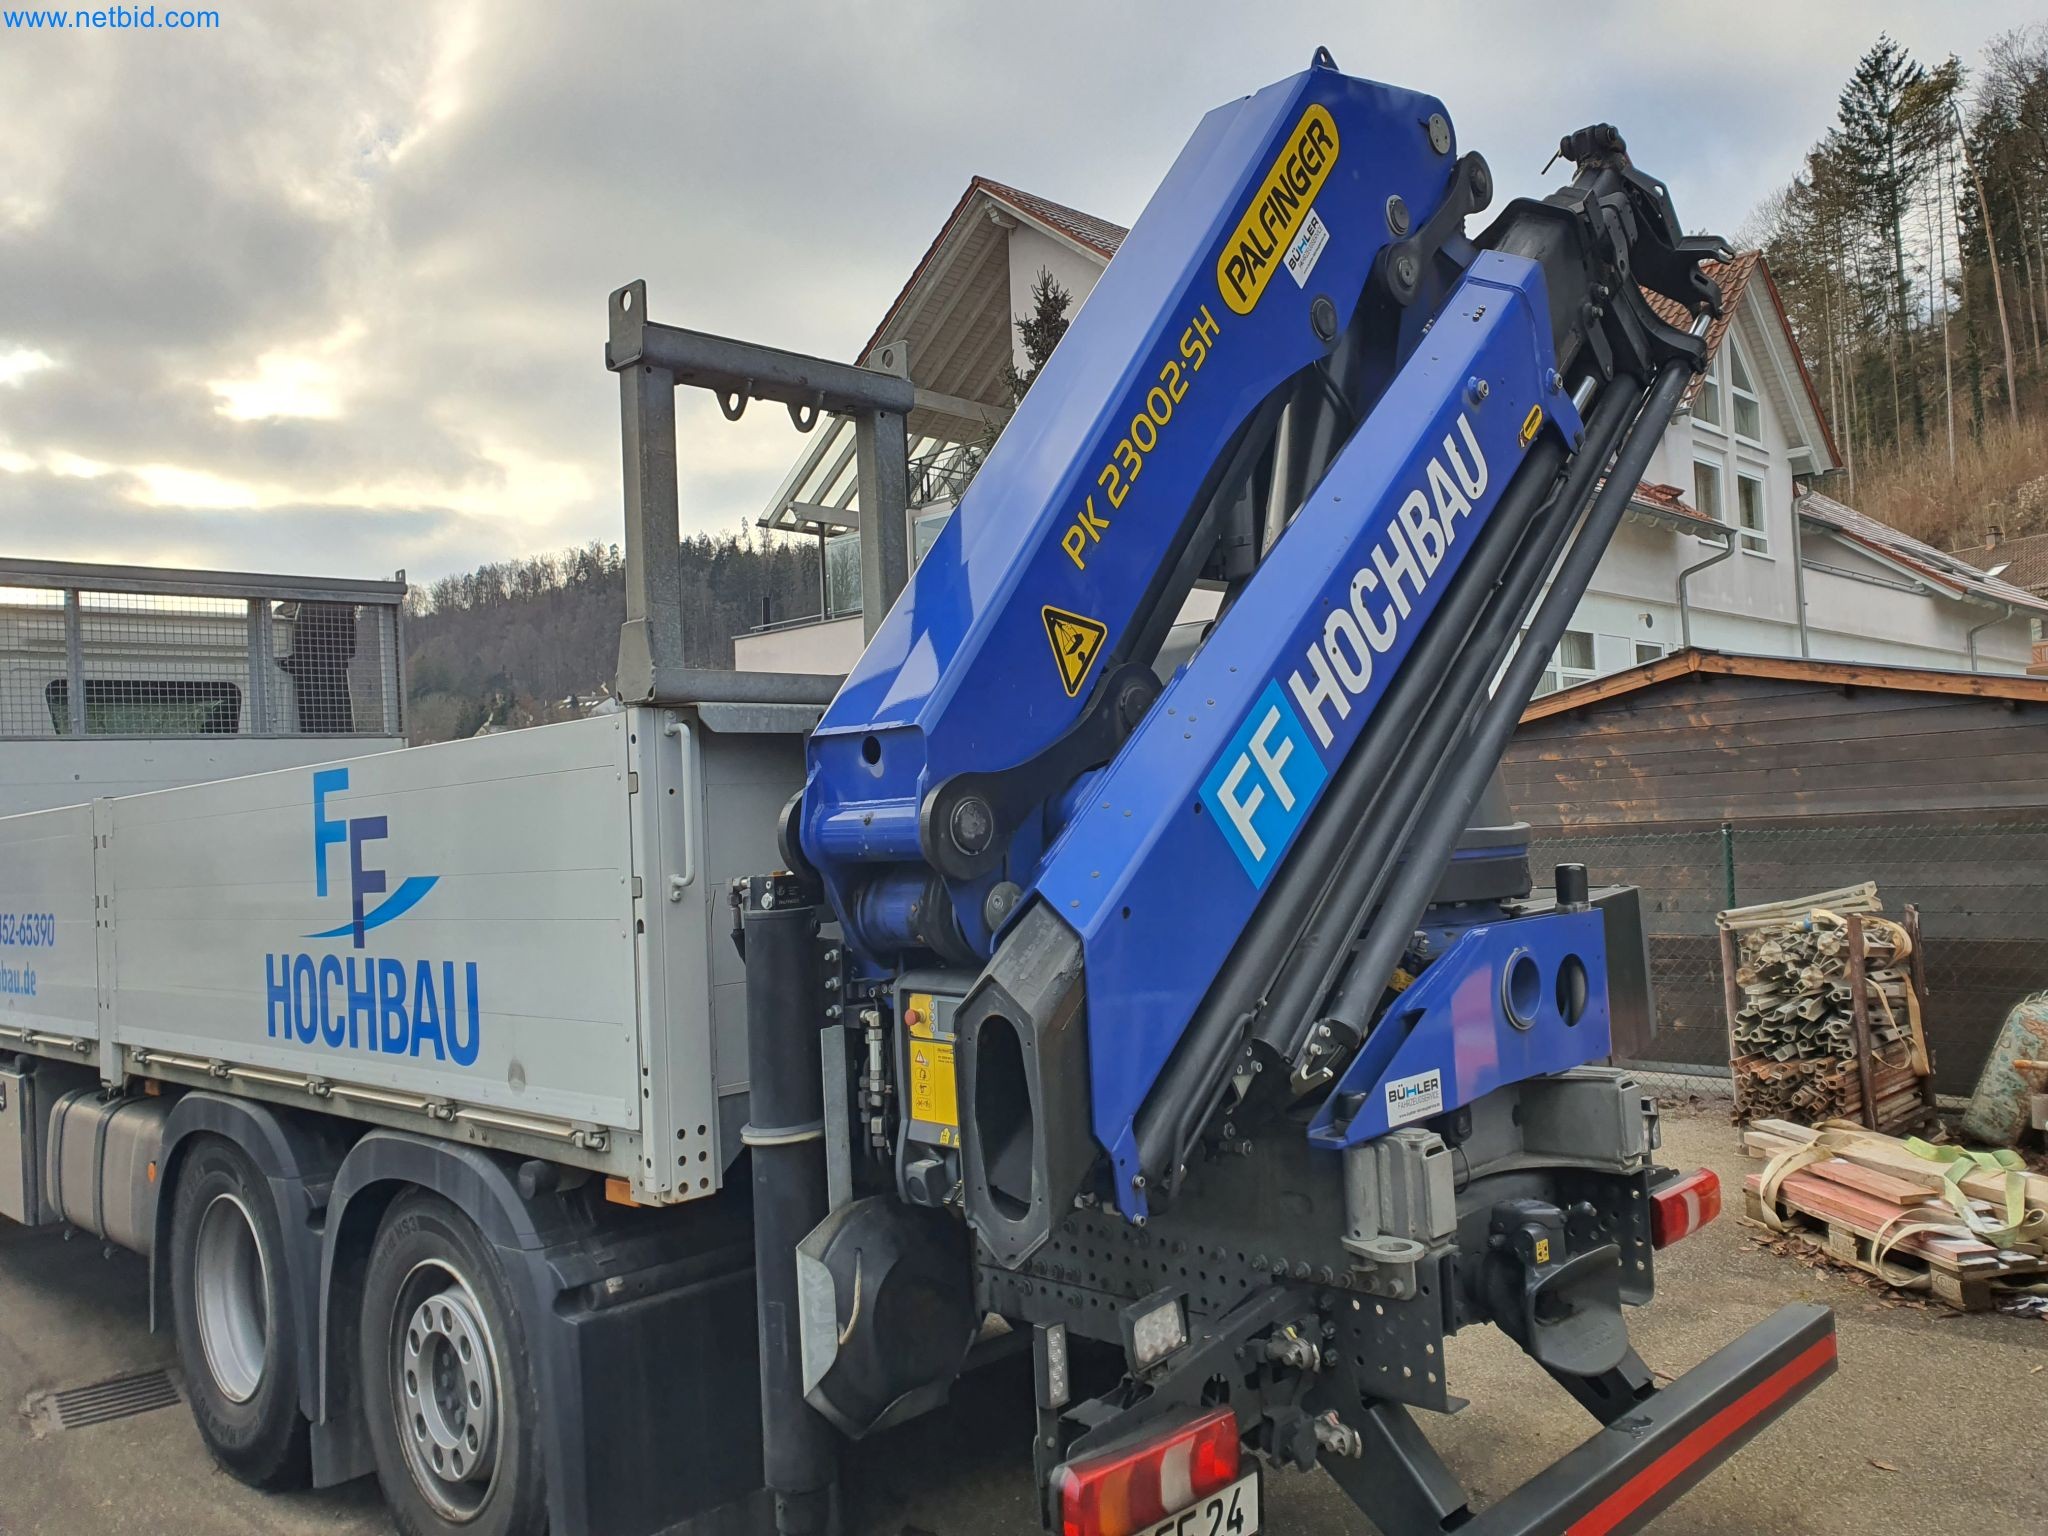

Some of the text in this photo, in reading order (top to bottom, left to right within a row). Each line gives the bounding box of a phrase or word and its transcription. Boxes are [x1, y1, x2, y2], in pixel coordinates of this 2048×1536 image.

[1224, 117, 1334, 303] PALFINGER
[1288, 216, 1319, 271] BÜHLER
[1061, 495, 1109, 570] PK
[1217, 412, 1490, 862] FF HOCHBAU
[0, 913, 55, 947] 52-65390
[0, 960, 36, 996] bau.de
[266, 953, 480, 1067] HOCHBAU
[1388, 1078, 1439, 1103] BÜHLER
[1206, 1486, 1244, 1536] 24
